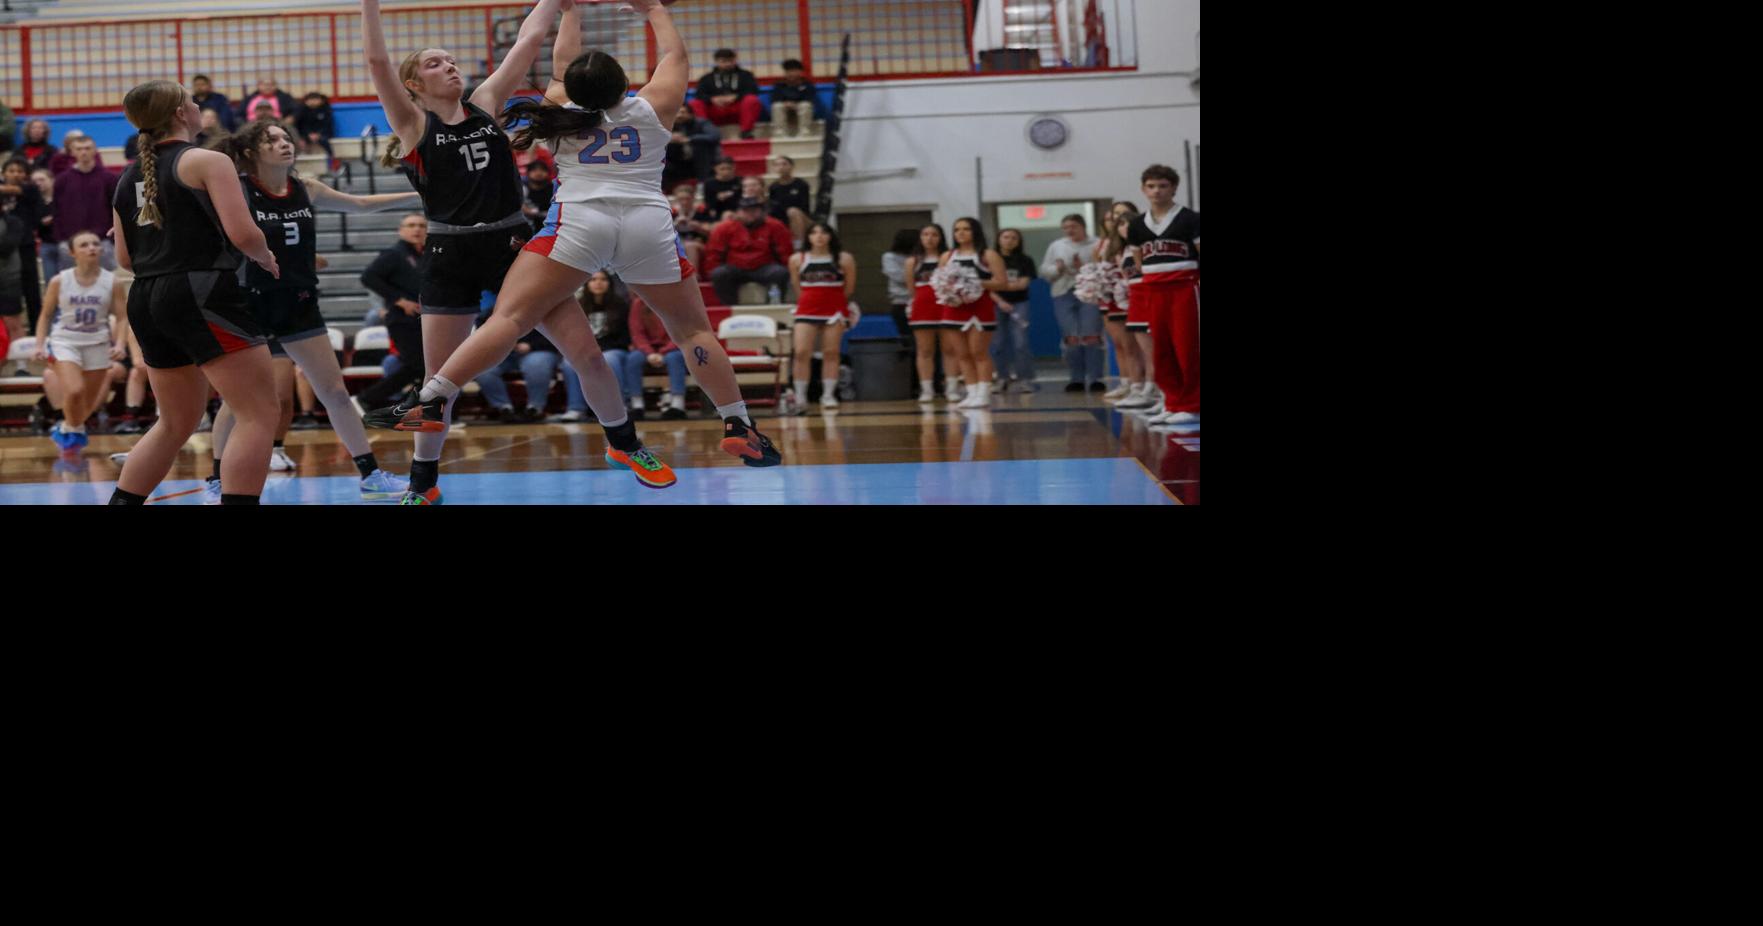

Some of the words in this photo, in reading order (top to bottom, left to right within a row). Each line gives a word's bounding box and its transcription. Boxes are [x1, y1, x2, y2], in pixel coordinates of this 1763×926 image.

[458, 141, 491, 171] 15
[577, 125, 641, 164] 23
[282, 221, 300, 246] 3
[70, 295, 103, 306] MARK
[75, 308, 97, 325] 10
